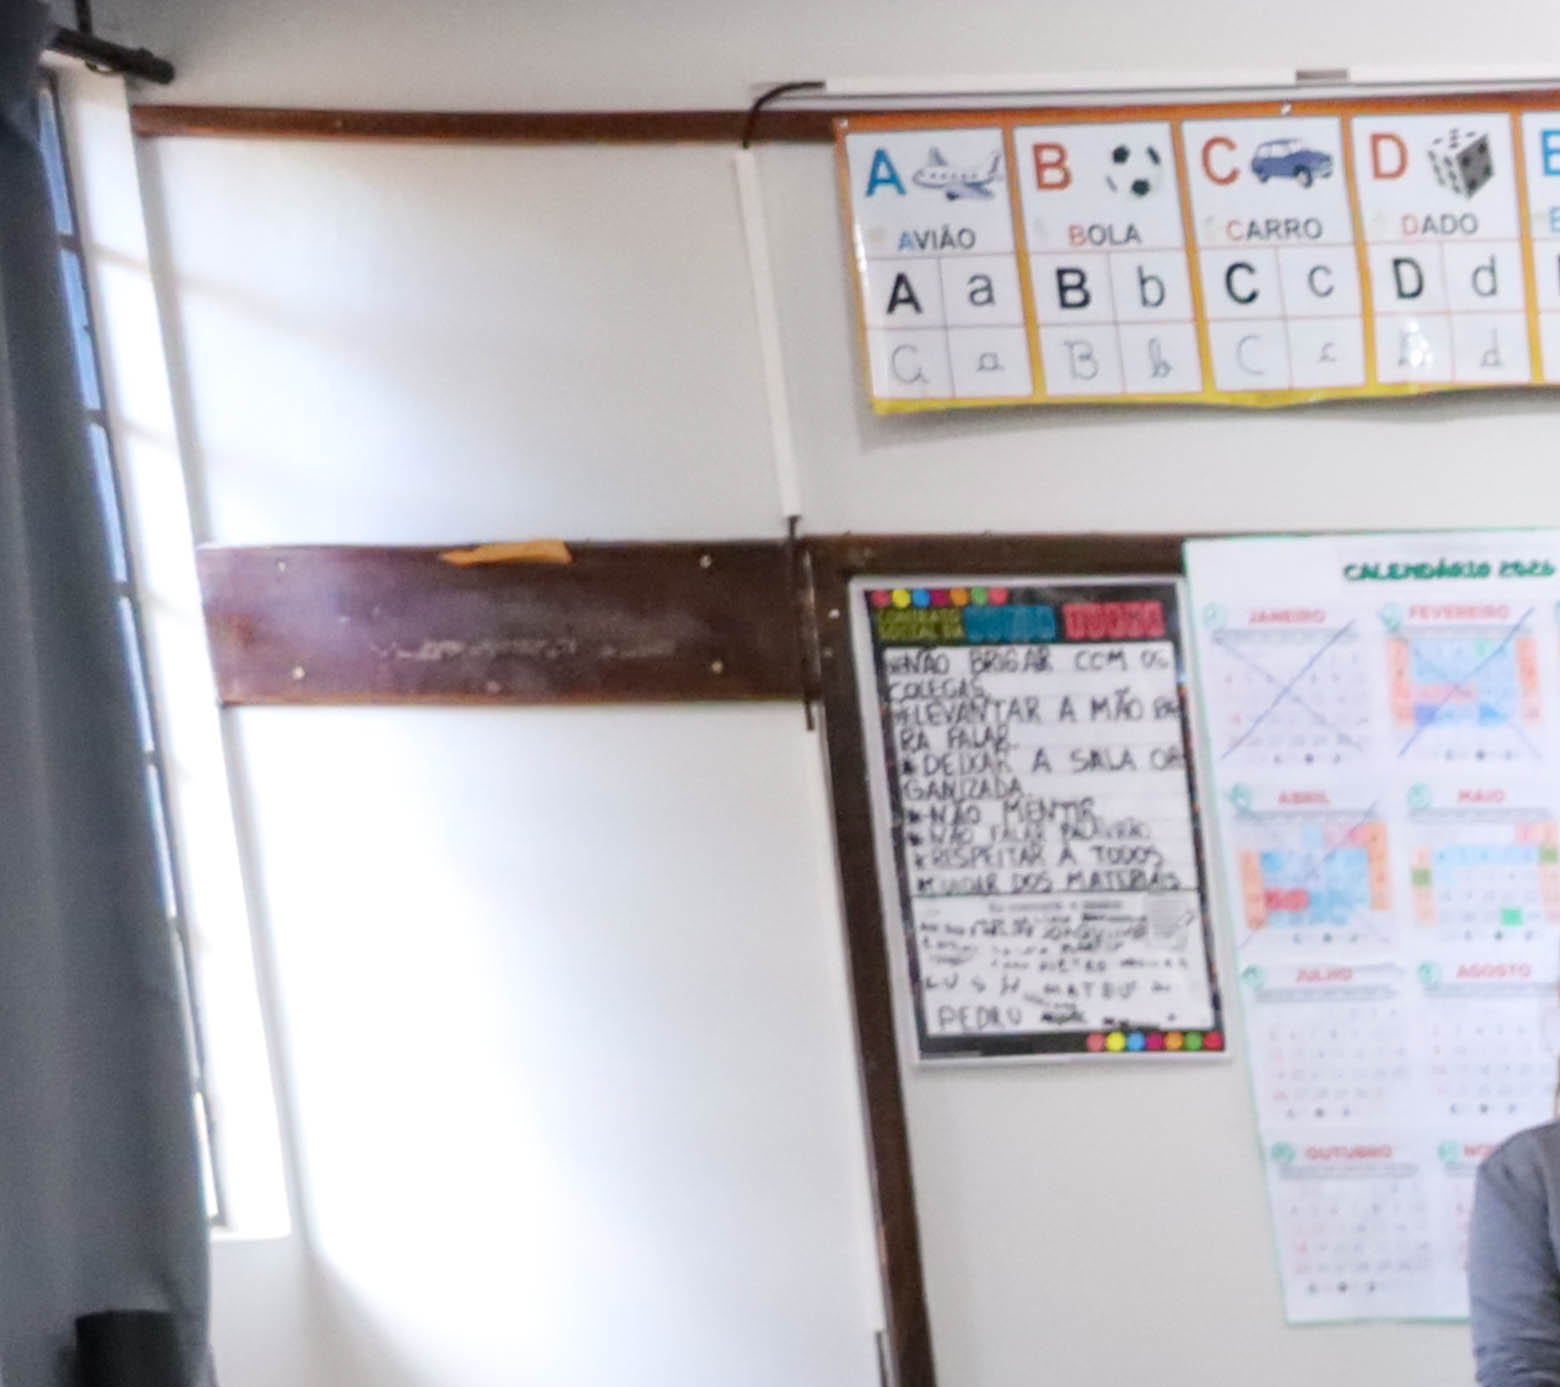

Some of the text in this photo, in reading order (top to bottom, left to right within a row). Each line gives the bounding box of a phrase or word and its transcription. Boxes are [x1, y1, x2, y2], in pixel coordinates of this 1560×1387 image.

[865, 148, 907, 196] A
[1032, 143, 1072, 189] B
[1201, 137, 1240, 184] C
[1371, 133, 1408, 178] D
[900, 224, 976, 250] AVIÃO
[1069, 224, 1142, 245] BOLA
[1226, 218, 1322, 240] CARRO
[1401, 215, 1478, 236] DADO
[887, 274, 996, 314] A a
[1057, 267, 1164, 309] B b
[1225, 263, 1334, 304] C c
[1393, 257, 1497, 300] D d
